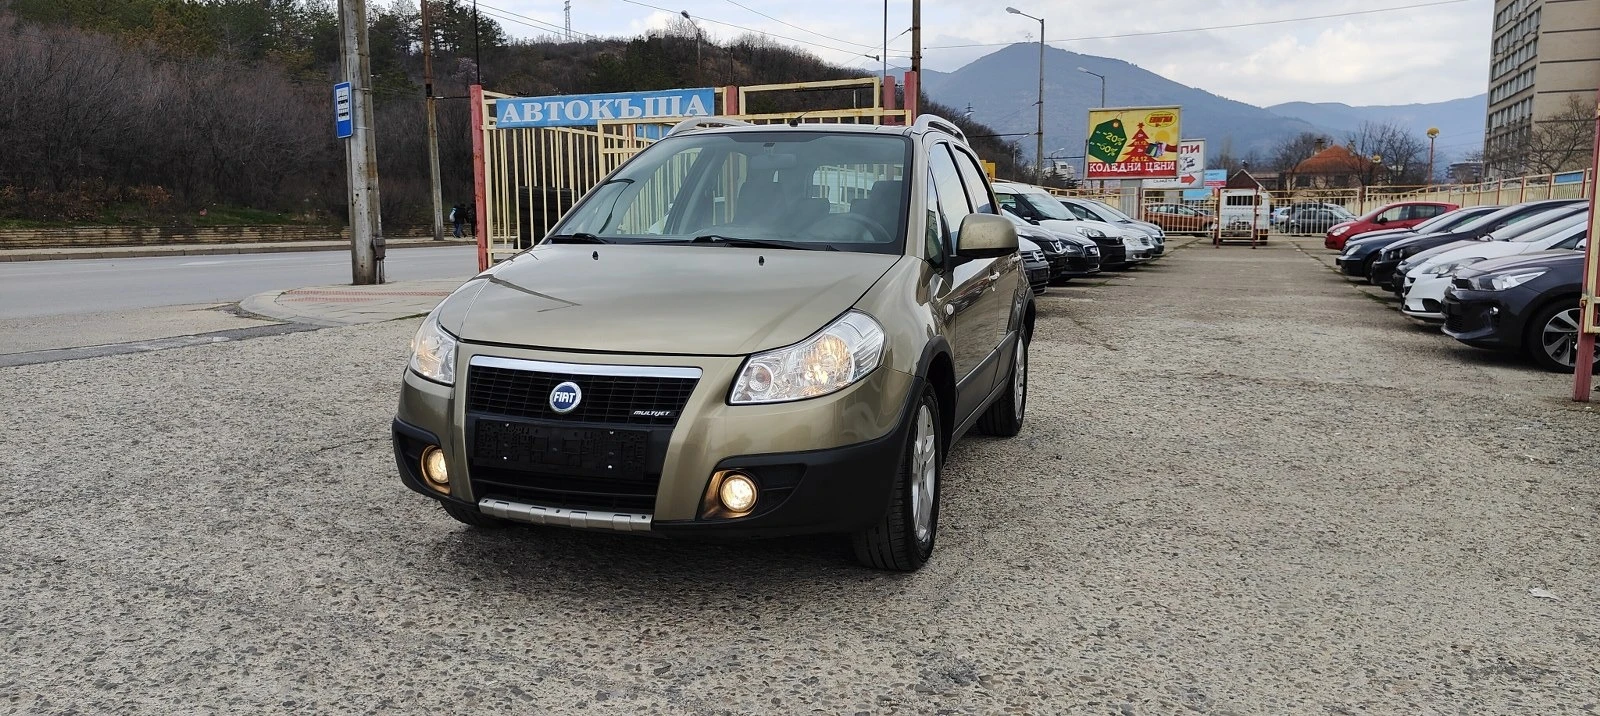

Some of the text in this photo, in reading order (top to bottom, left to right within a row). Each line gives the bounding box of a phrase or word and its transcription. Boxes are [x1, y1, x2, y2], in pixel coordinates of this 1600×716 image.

[1102, 132, 1125, 146] -20%
[1089, 162, 1175, 172] КОЛЕДНИ ЦЕНИ
[553, 391, 576, 403] FIAT
